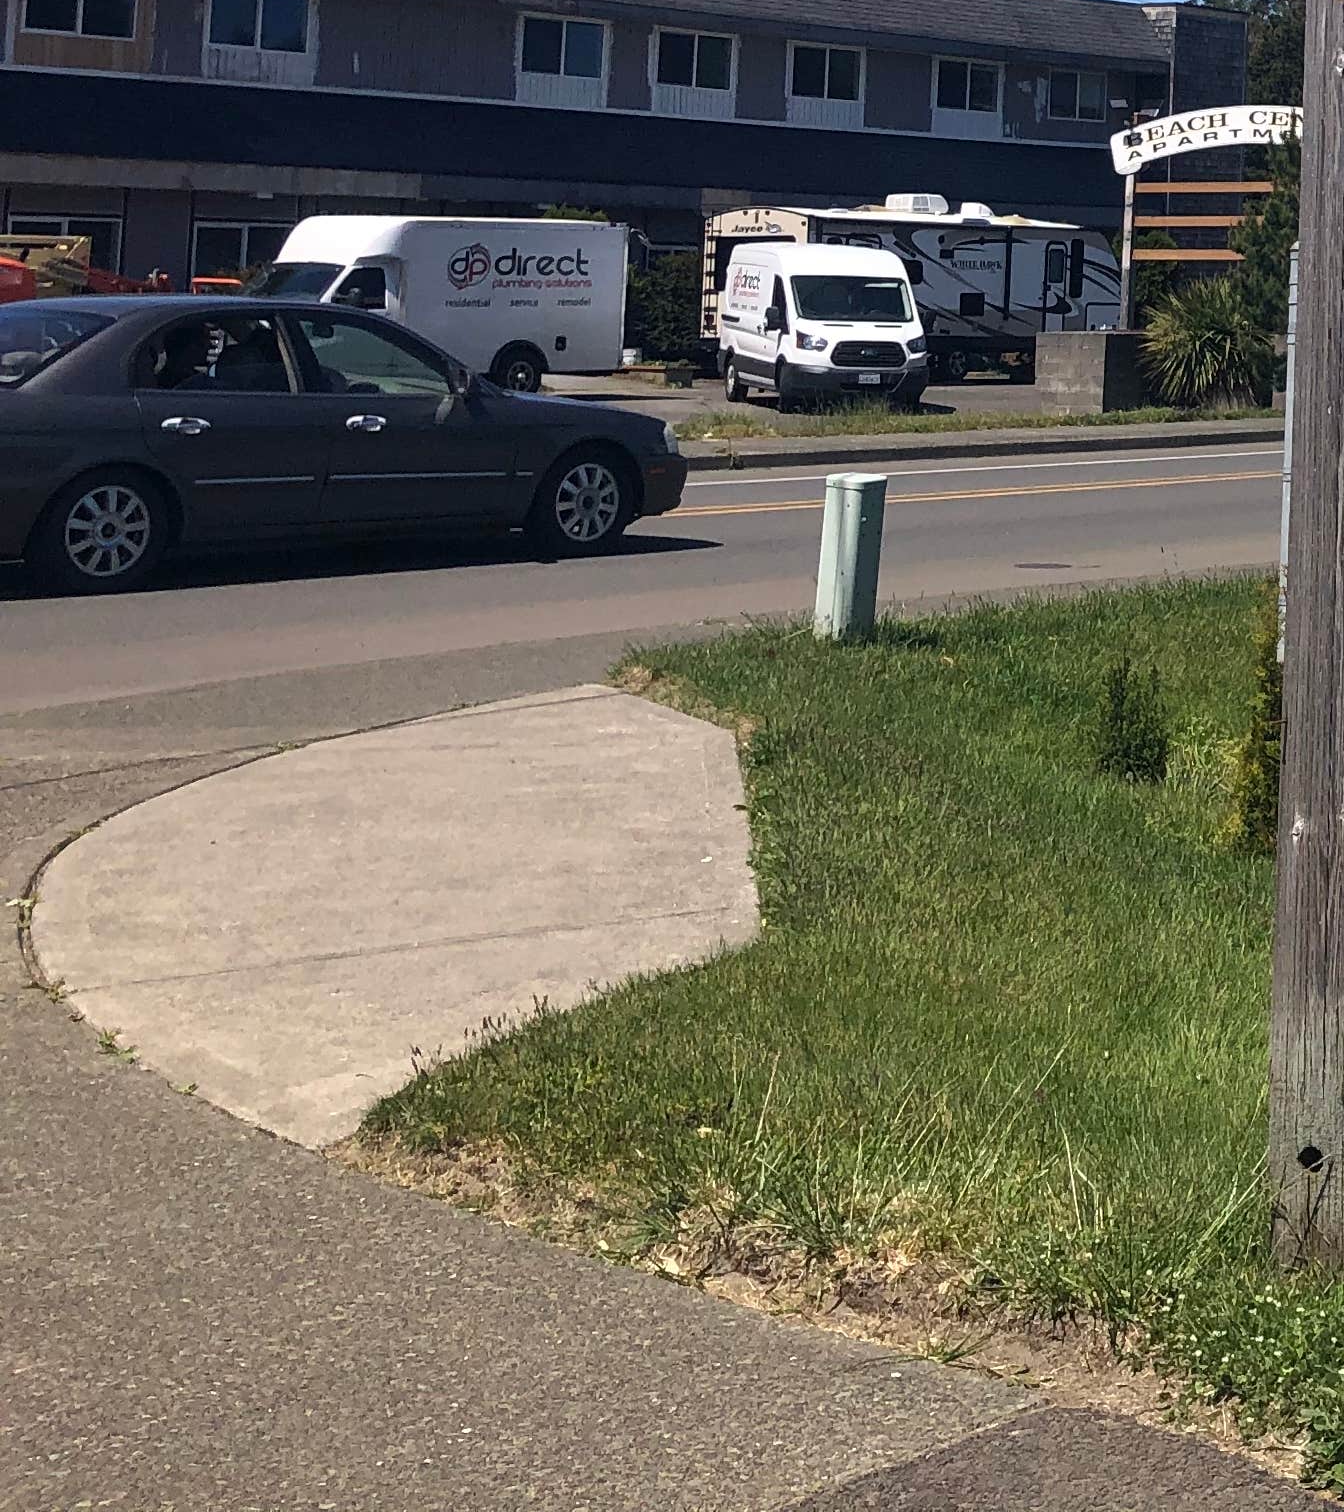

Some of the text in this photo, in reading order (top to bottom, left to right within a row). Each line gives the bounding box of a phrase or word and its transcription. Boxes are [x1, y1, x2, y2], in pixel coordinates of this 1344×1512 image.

[1123, 112, 1230, 149] BEACH
[731, 224, 763, 234] Jayco
[494, 247, 589, 276] direct
[492, 278, 542, 291] plumbing
